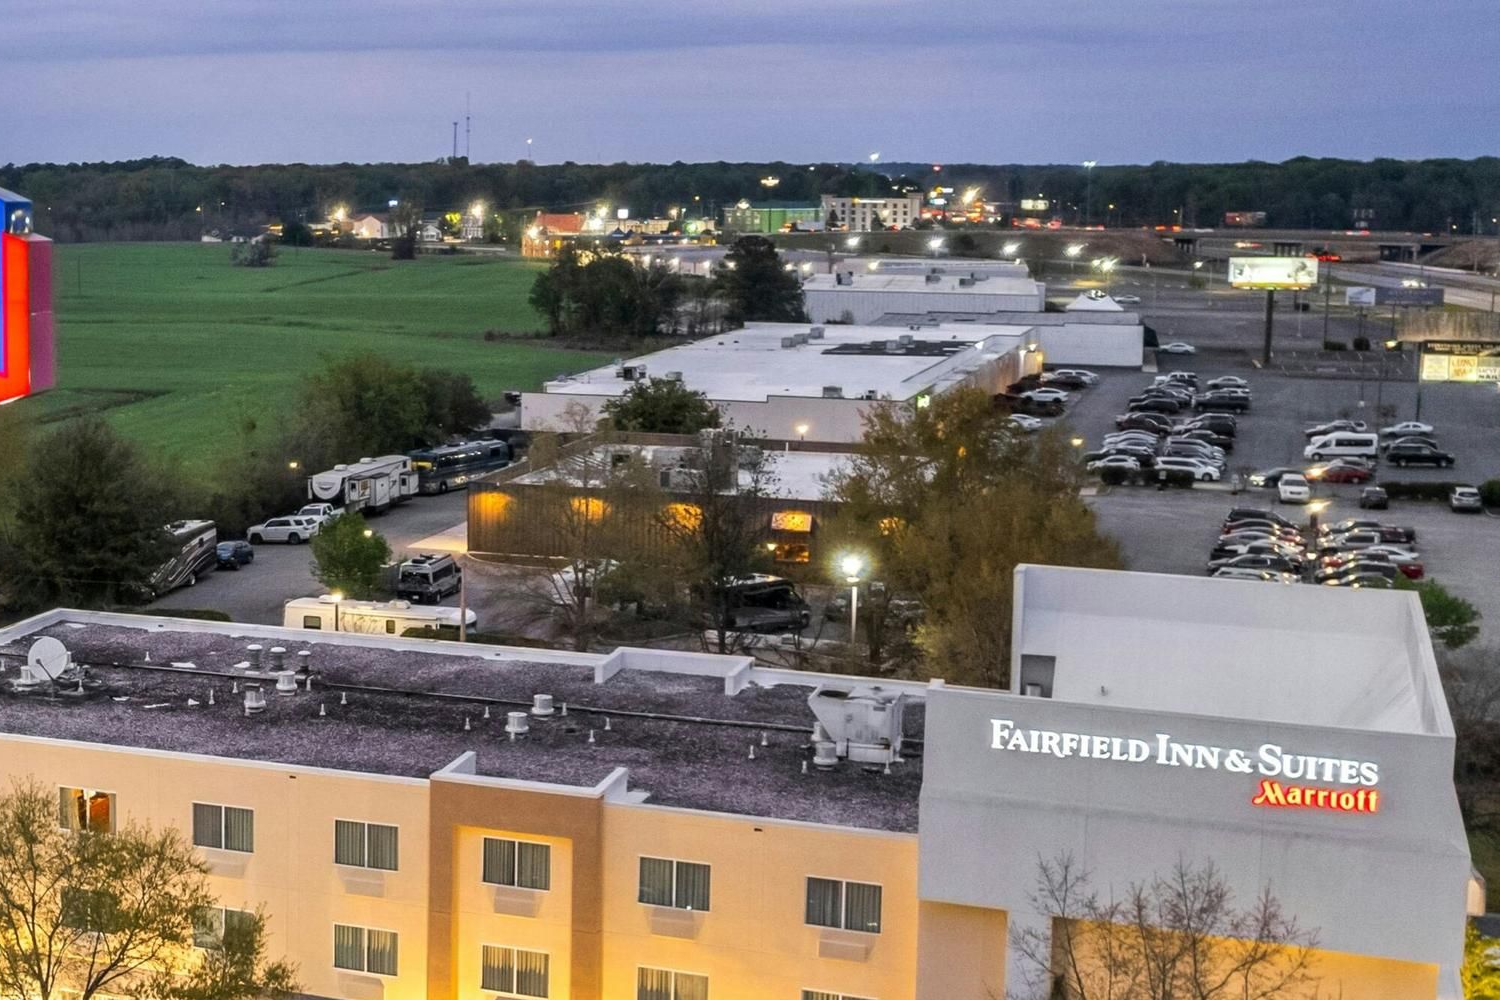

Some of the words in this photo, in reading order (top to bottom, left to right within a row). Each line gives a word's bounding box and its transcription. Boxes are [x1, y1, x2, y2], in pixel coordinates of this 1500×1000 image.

[990, 718, 1150, 763] FAIRFIELD
[1155, 734, 1219, 770] INN
[1225, 749, 1254, 774] &
[1258, 744, 1379, 786] SUITES
[1253, 780, 1380, 812] Marriott
